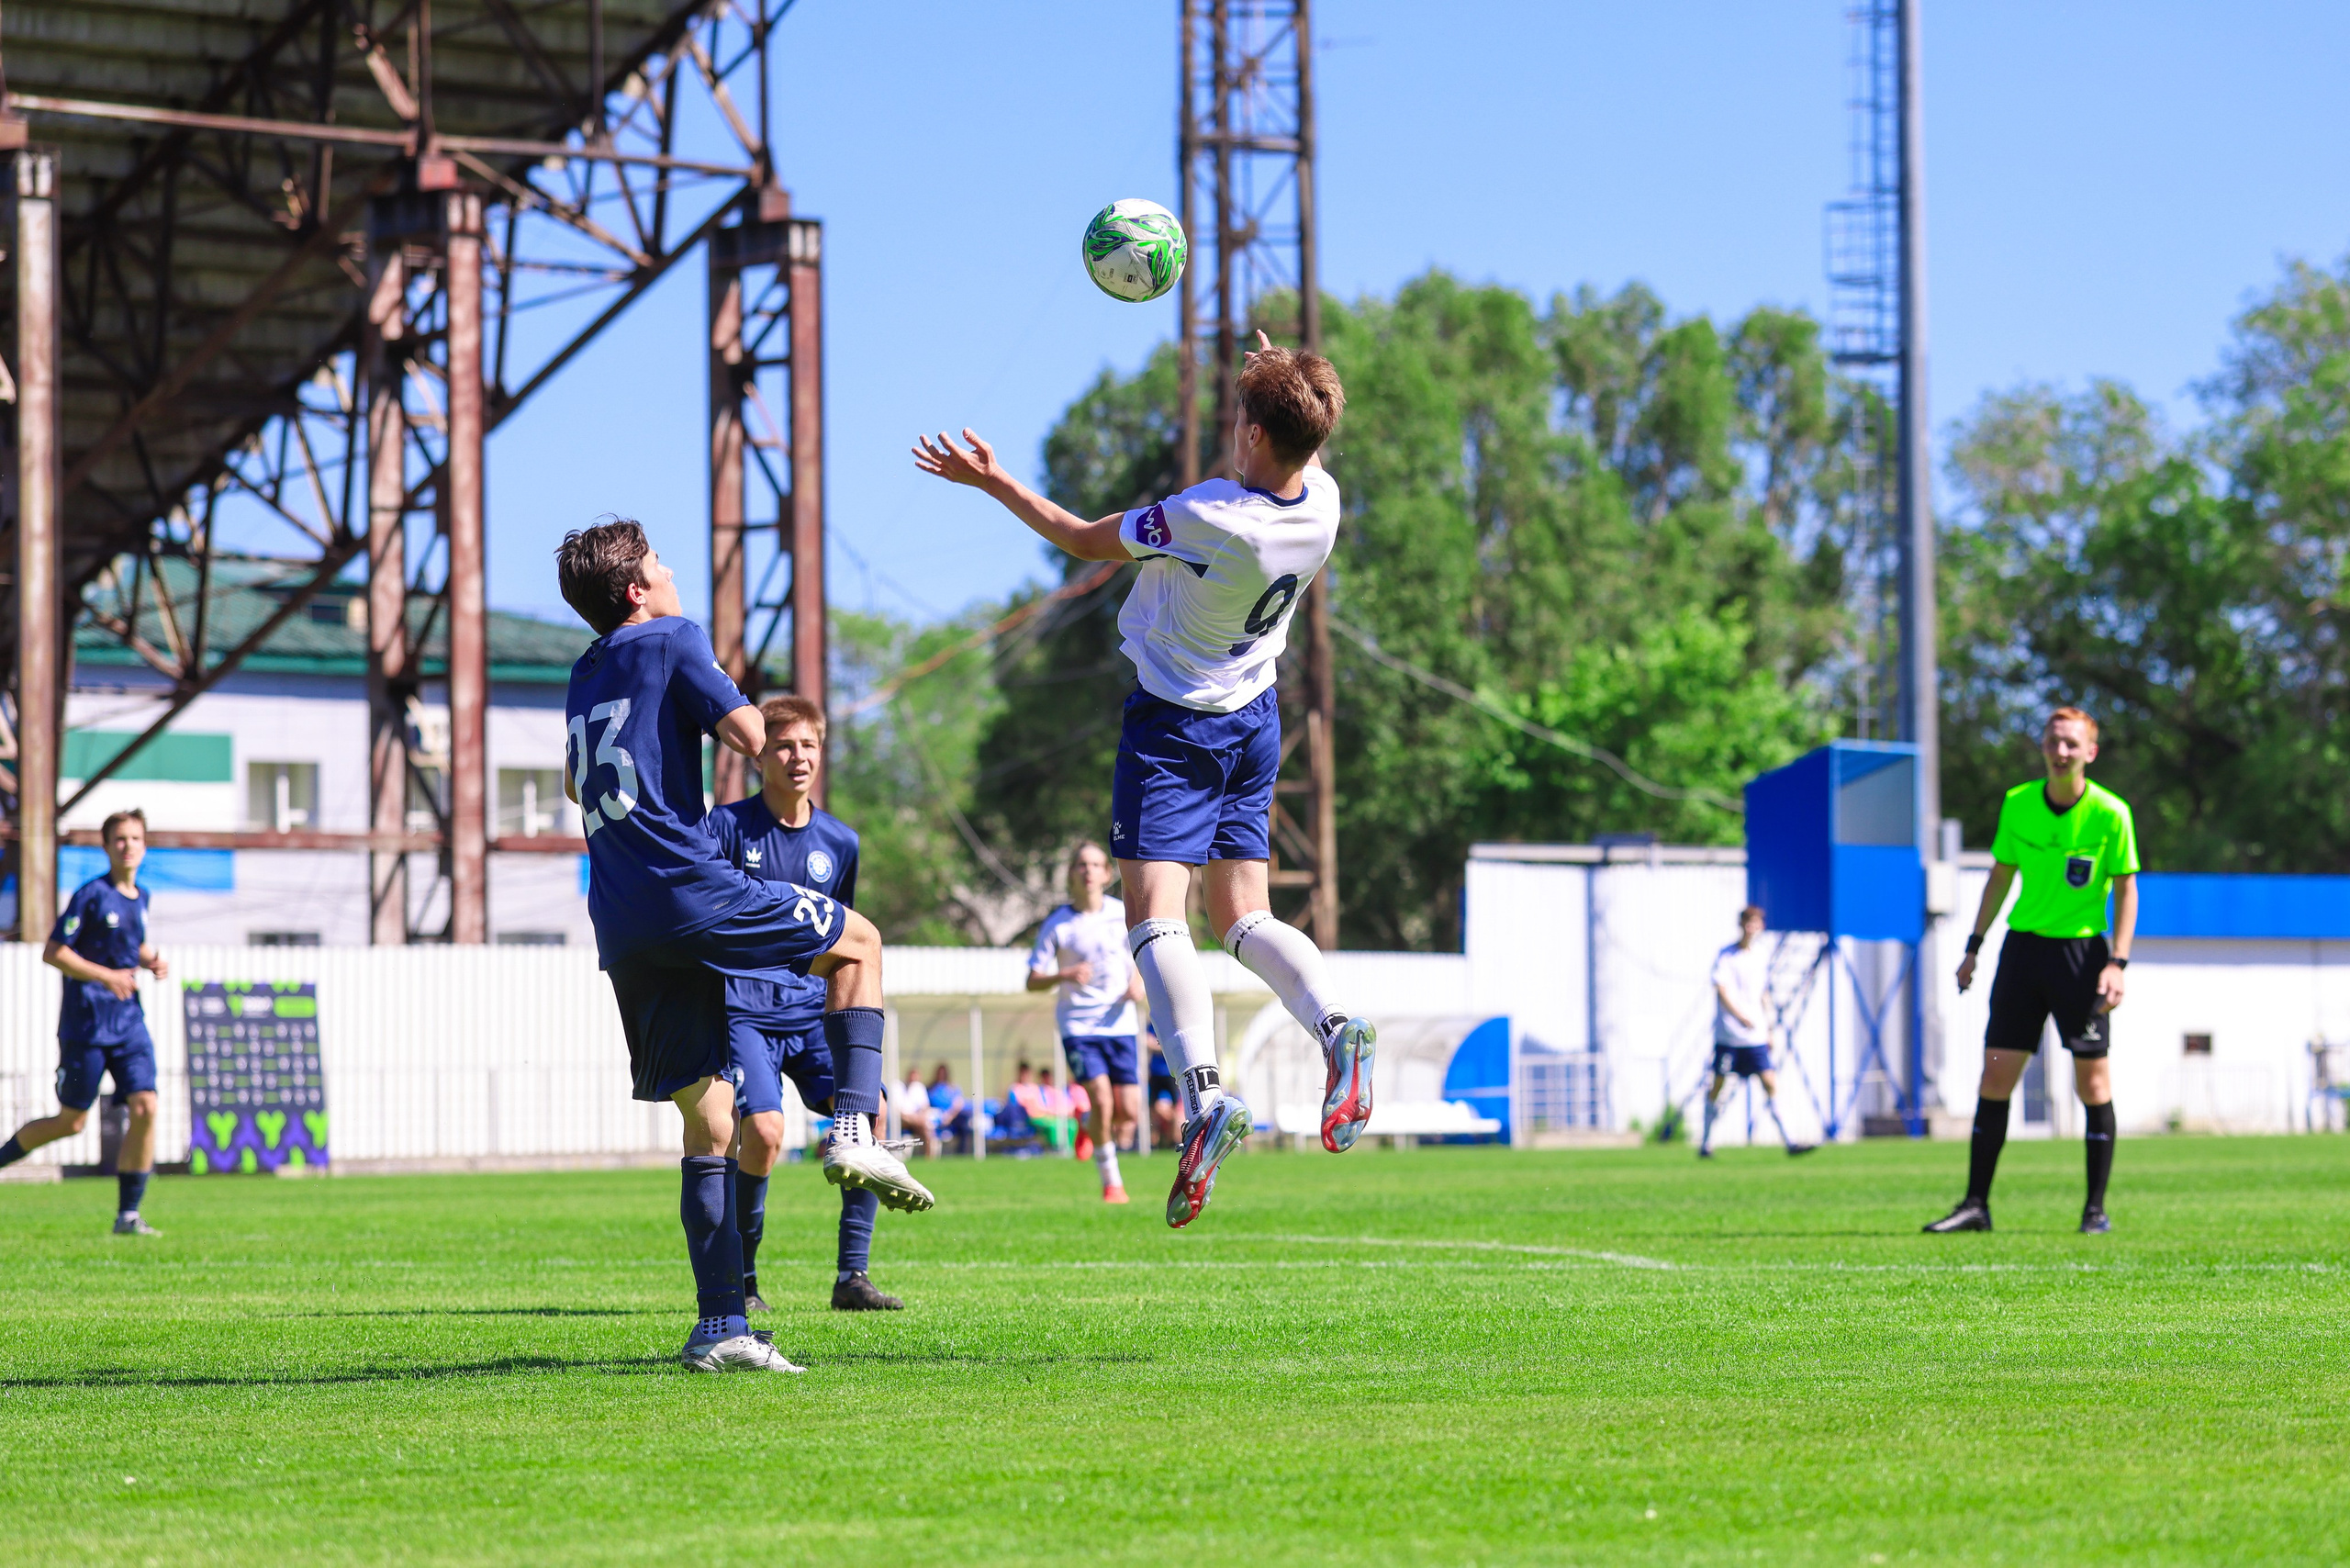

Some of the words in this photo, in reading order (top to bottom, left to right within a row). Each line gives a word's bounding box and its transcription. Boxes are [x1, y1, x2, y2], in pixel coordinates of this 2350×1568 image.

[567, 698, 639, 838] 23
[790, 883, 834, 938] 23
[1184, 1070, 1200, 1115] PEDESIGN
